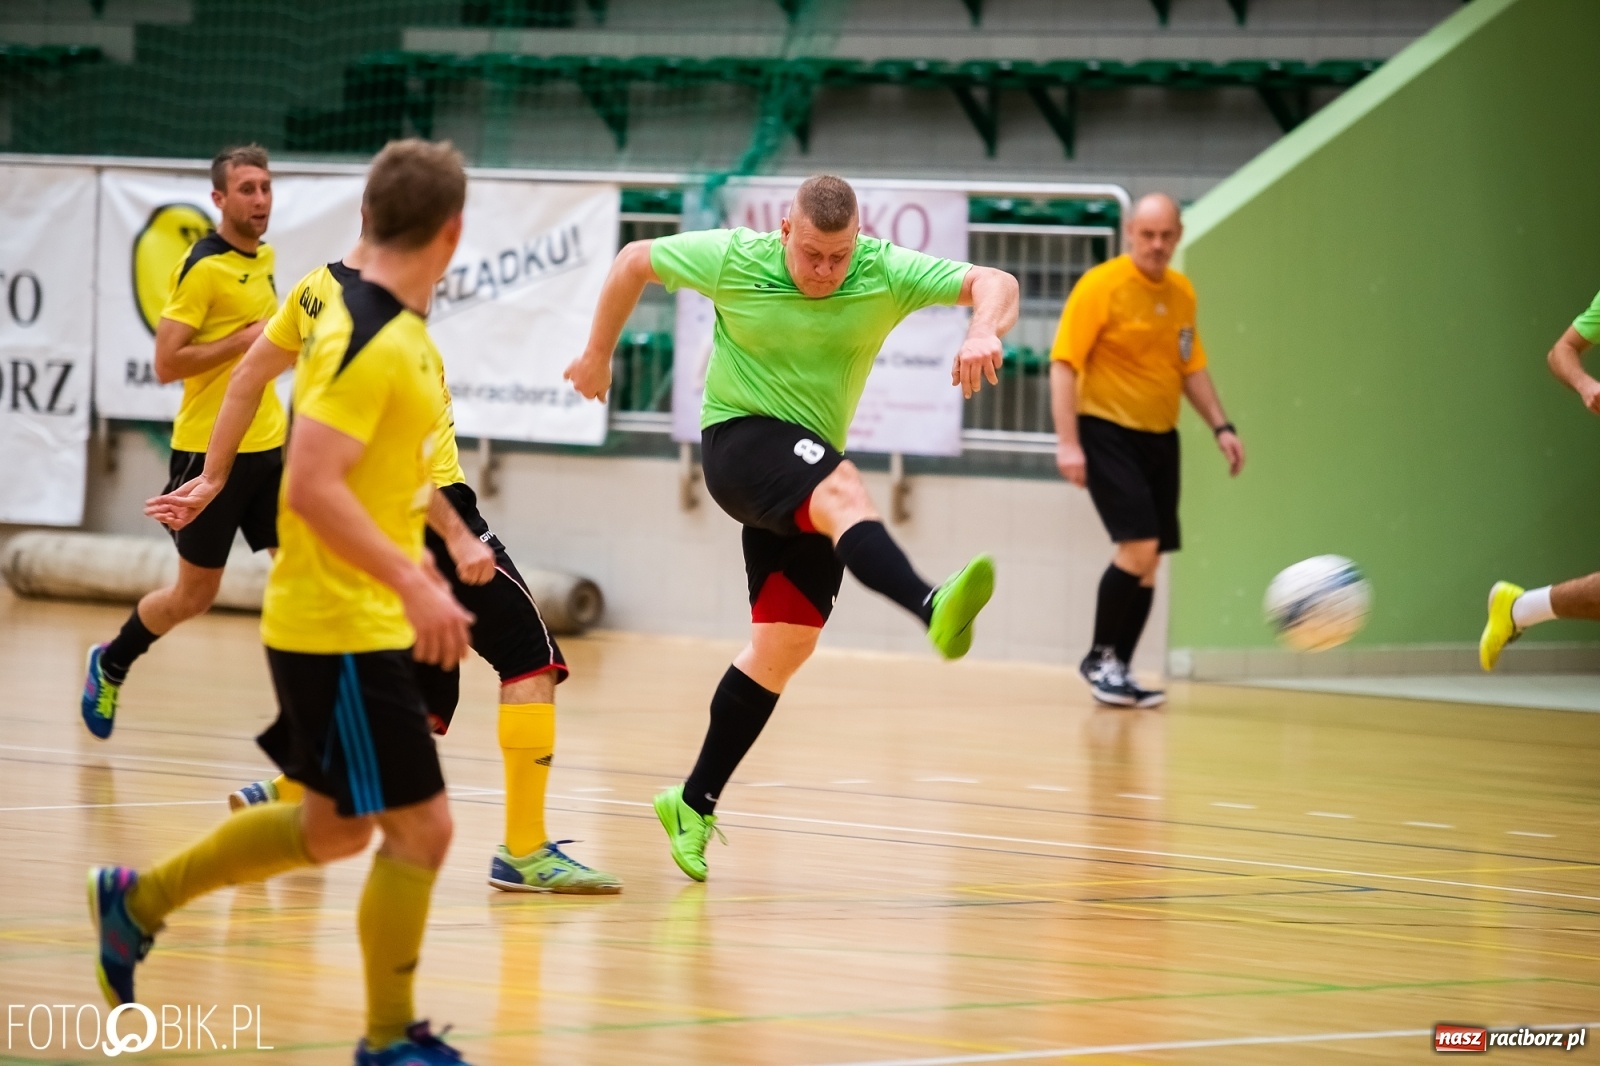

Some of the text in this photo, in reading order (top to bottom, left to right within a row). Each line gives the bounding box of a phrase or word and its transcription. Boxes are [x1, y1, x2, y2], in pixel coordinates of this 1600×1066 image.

[0, 269, 42, 327] O
[0, 357, 76, 415] RZ
[794, 438, 825, 464] 8
